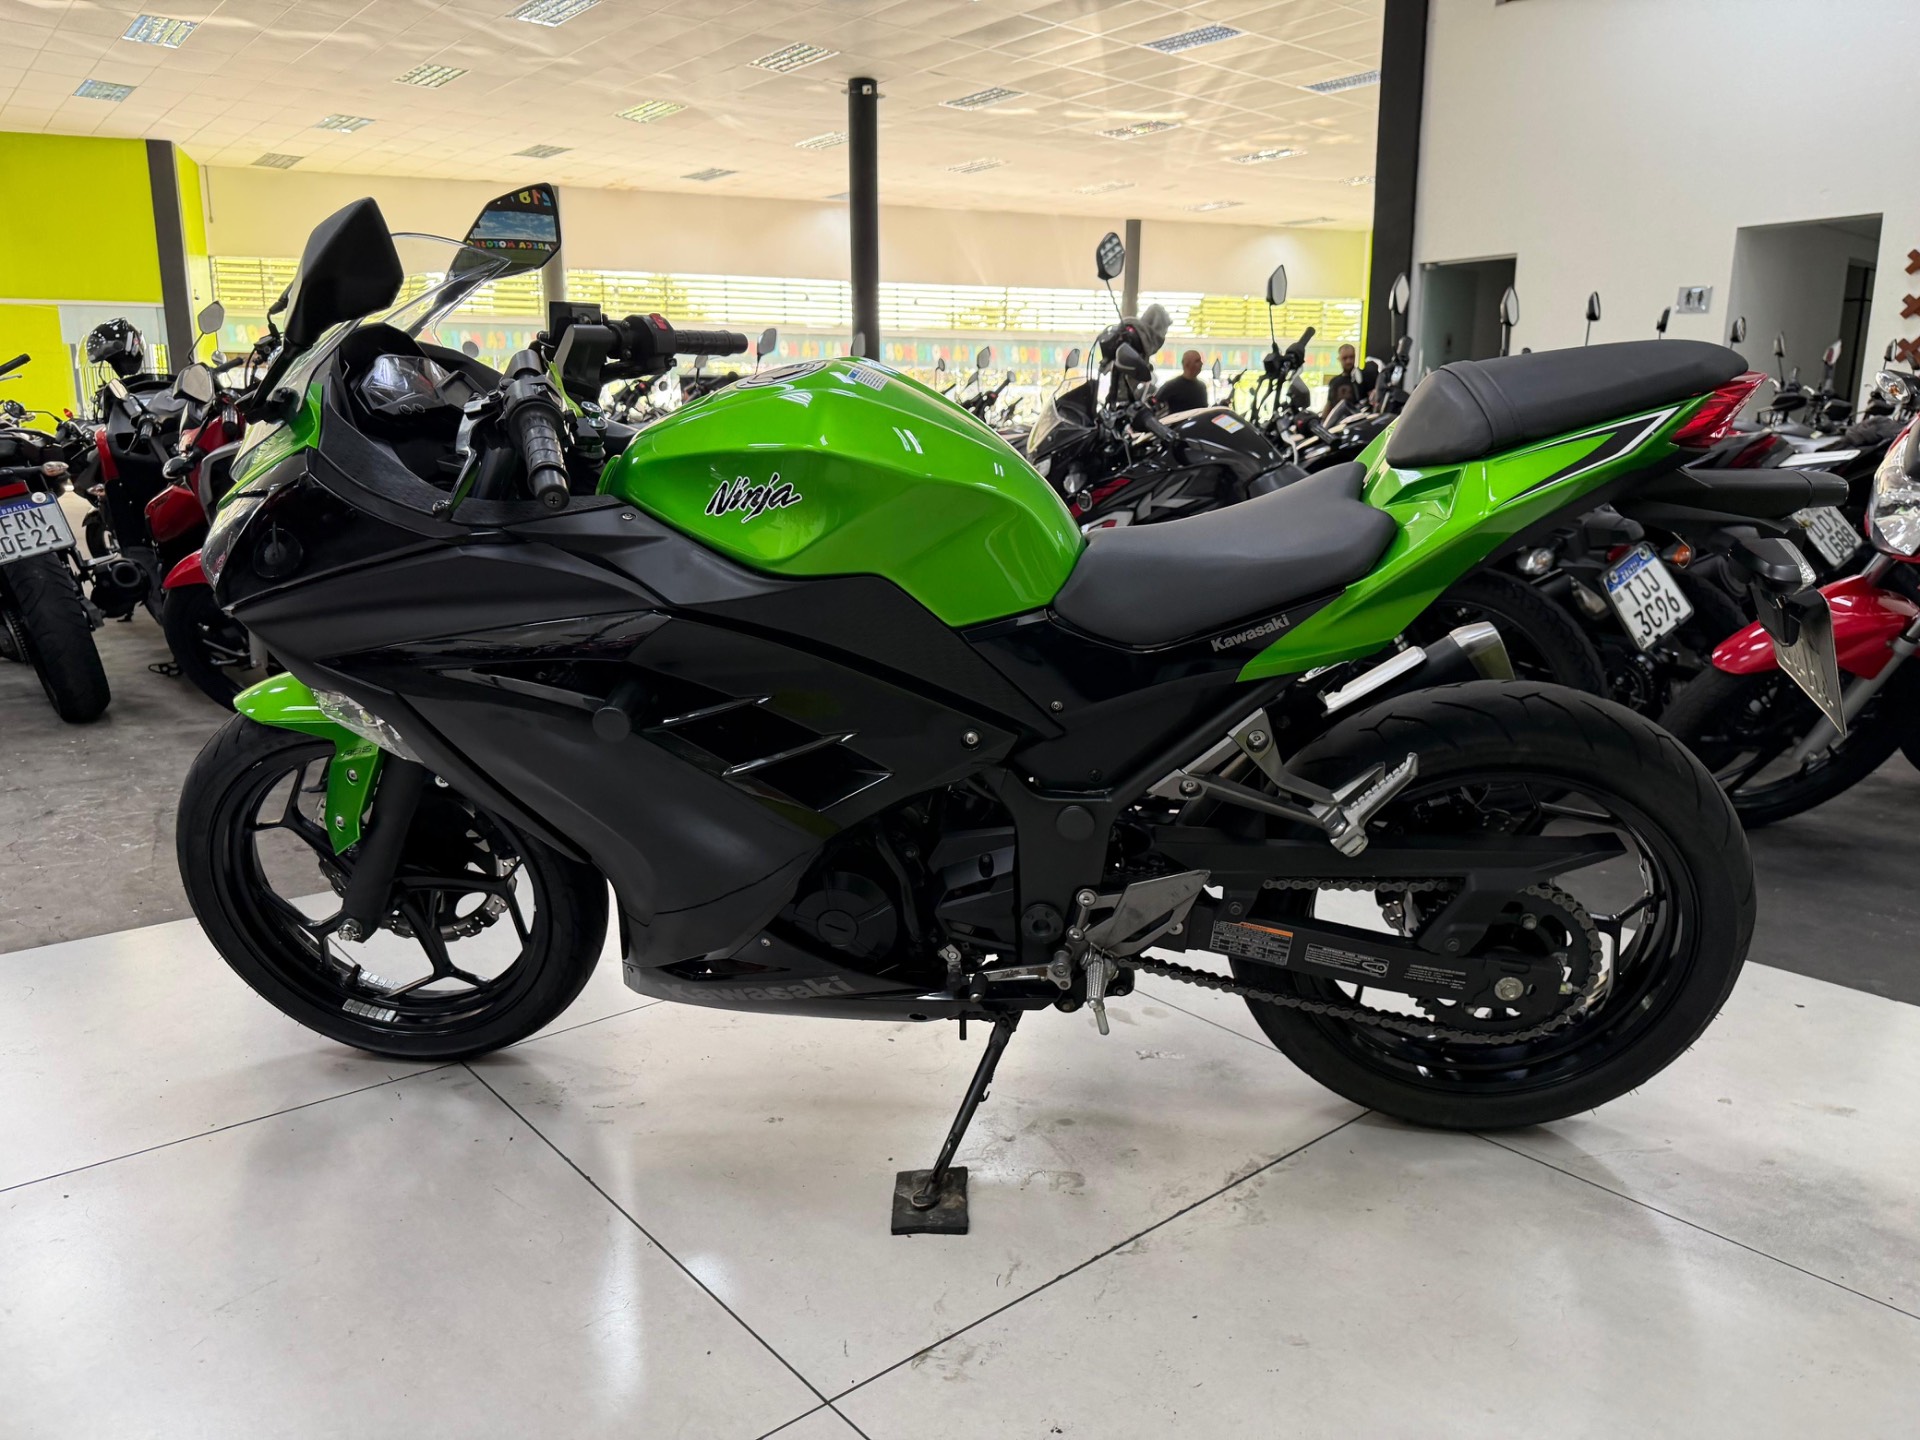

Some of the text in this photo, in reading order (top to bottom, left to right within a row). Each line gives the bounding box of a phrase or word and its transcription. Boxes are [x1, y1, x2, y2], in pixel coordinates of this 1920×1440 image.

[1, 503, 32, 515] BRASIL
[704, 472, 802, 524] Ninja
[0, 507, 47, 535] FRN
[1623, 567, 1661, 607] TJJ
[1634, 588, 1681, 637] 3C96
[1210, 613, 1290, 652] Kawasaki
[658, 975, 857, 1001] Kawasaki
